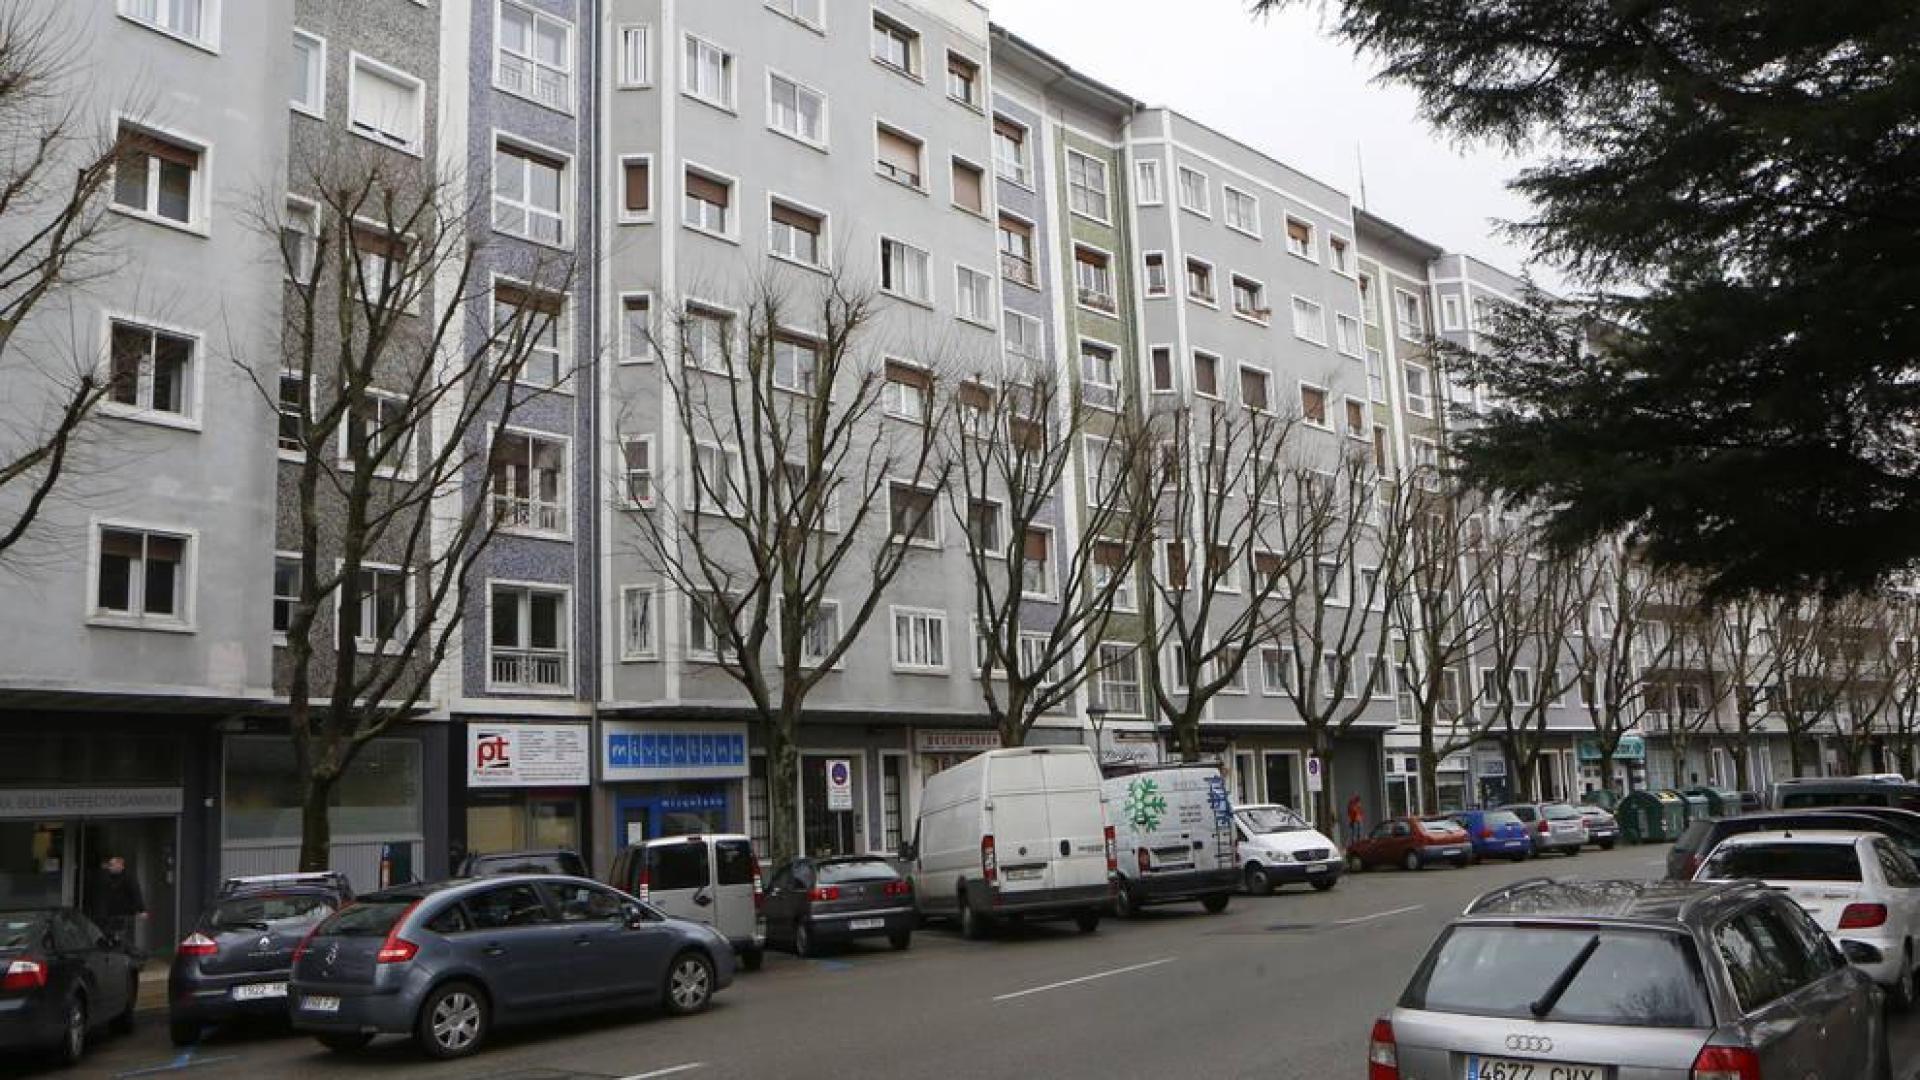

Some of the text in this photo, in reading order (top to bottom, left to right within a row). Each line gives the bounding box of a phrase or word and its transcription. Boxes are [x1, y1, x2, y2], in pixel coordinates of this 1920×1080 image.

[477, 736, 510, 768] pt
[611, 739, 742, 759] miventana
[1479, 1060, 1535, 1080] 4677
